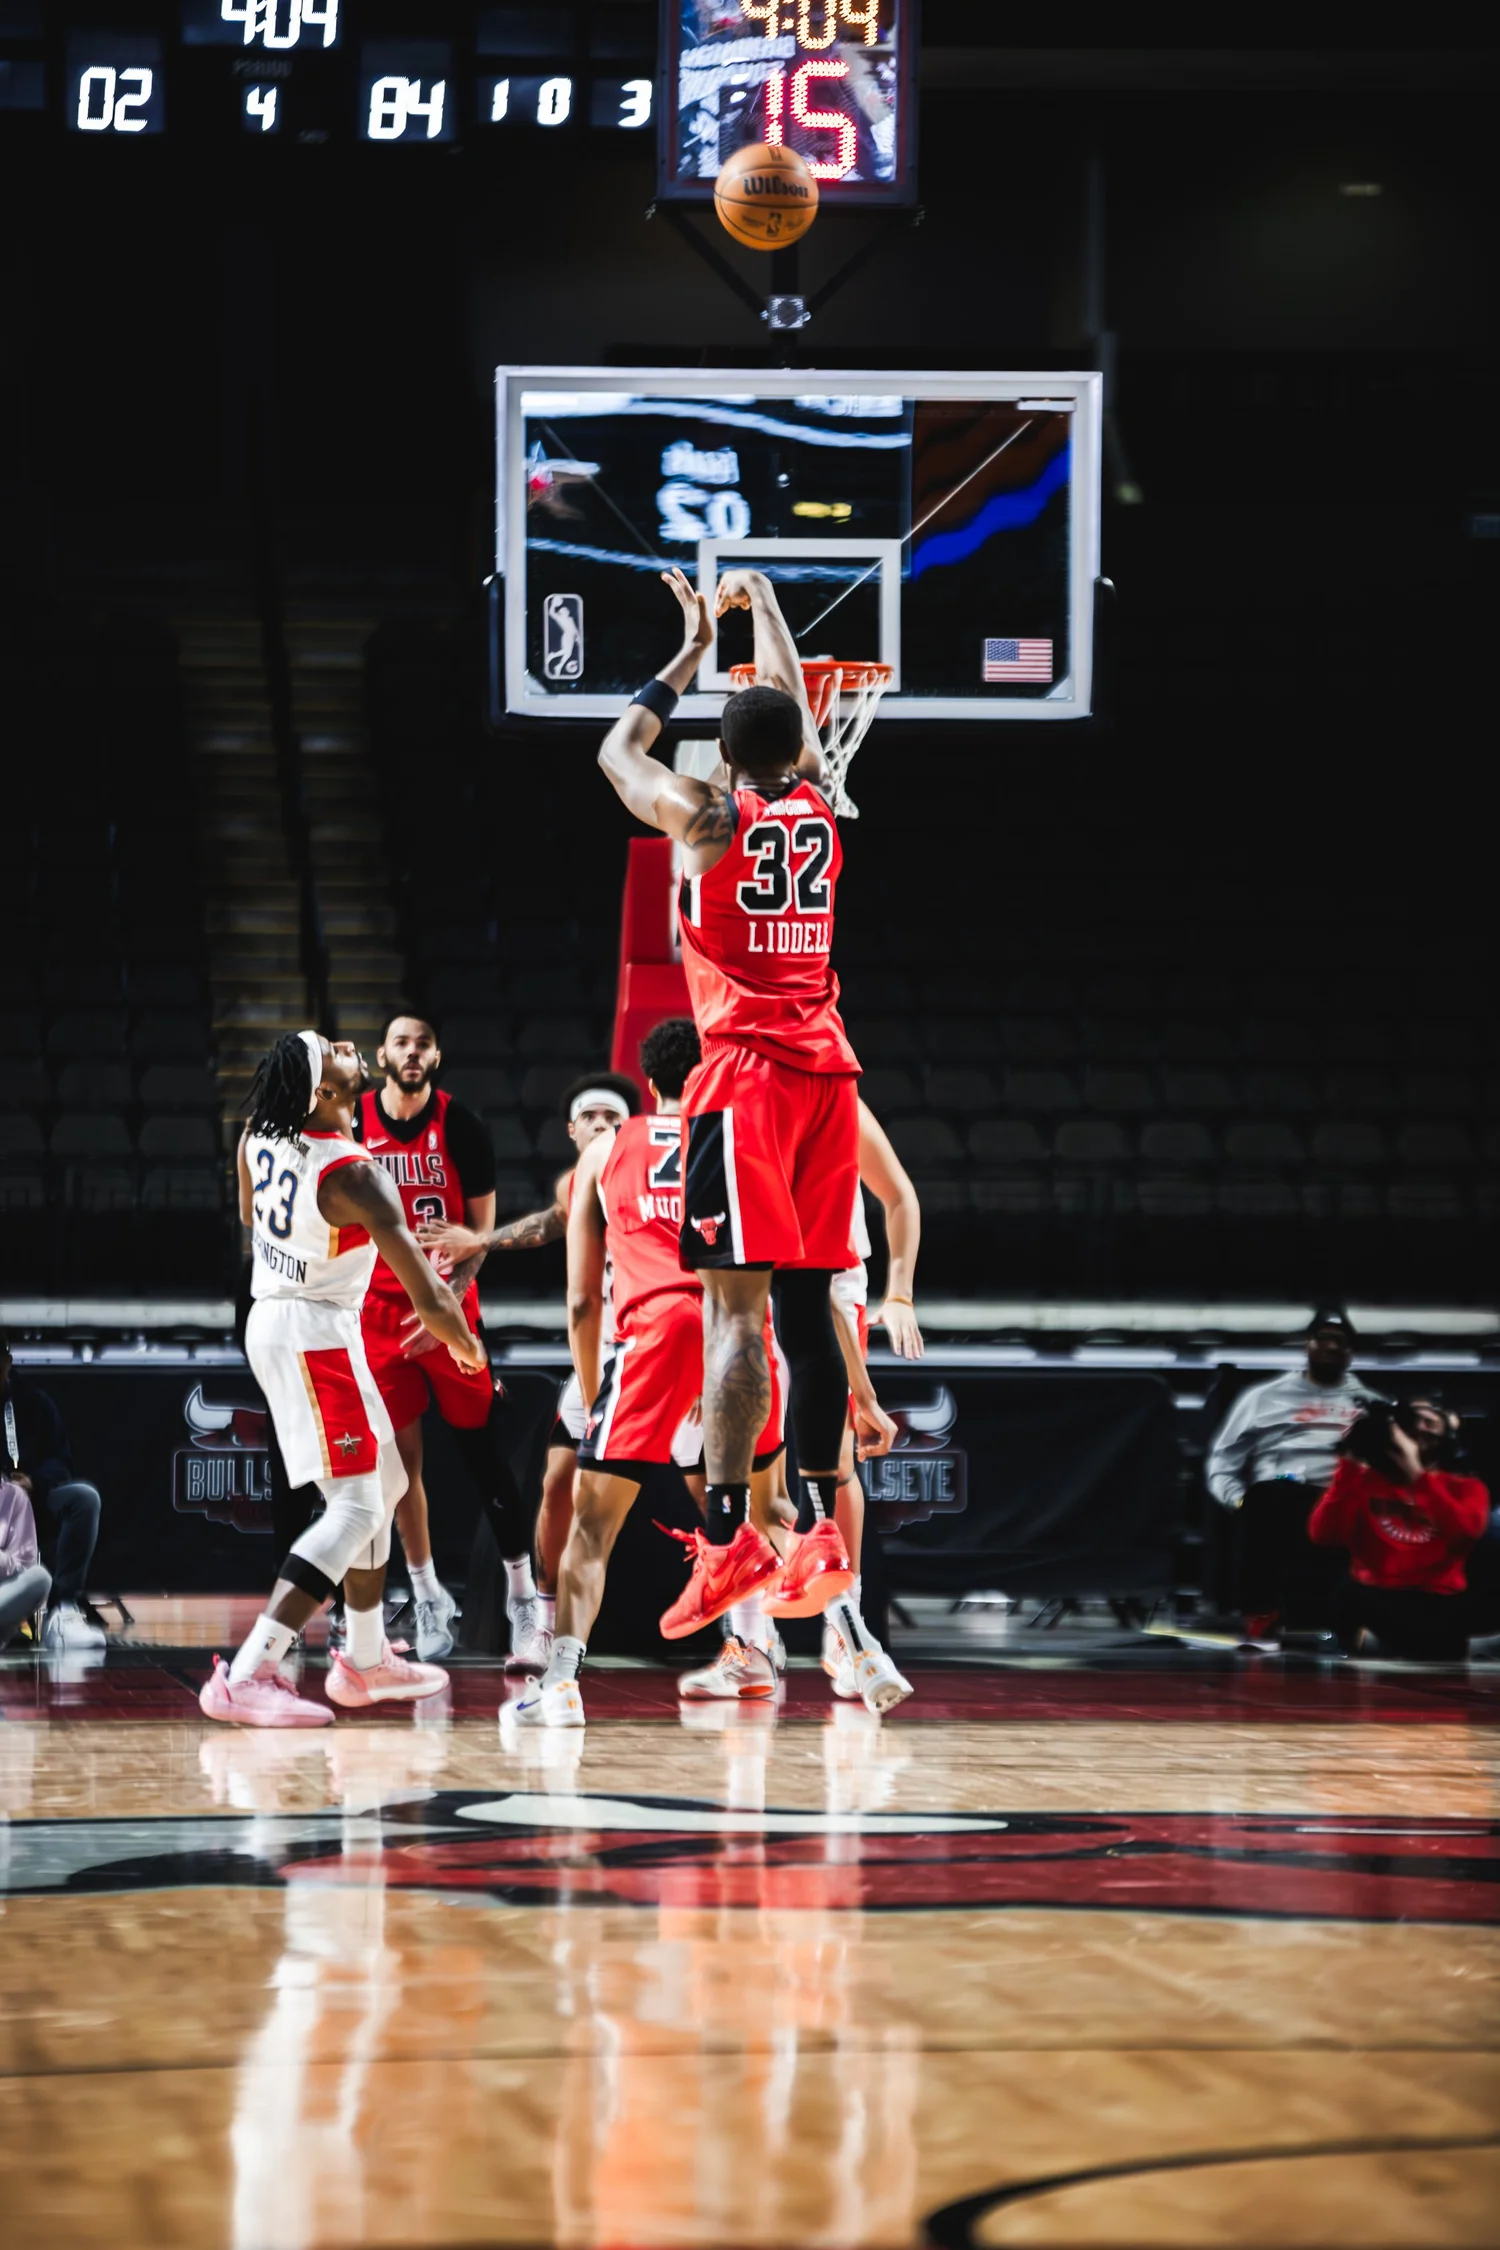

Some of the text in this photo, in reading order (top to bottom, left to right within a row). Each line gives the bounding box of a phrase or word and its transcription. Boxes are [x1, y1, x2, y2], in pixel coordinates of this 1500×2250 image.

[739, 0, 879, 49] 4:04
[77, 67, 153, 132] 02
[246, 86, 277, 131] 4
[367, 76, 445, 140] 84
[618, 79, 653, 127] 3
[764, 60, 857, 180] 15
[736, 817, 833, 915] 32
[747, 921, 830, 953] LIDDELL
[255, 1148, 298, 1240] 23
[374, 1153, 447, 1188] ULLS
